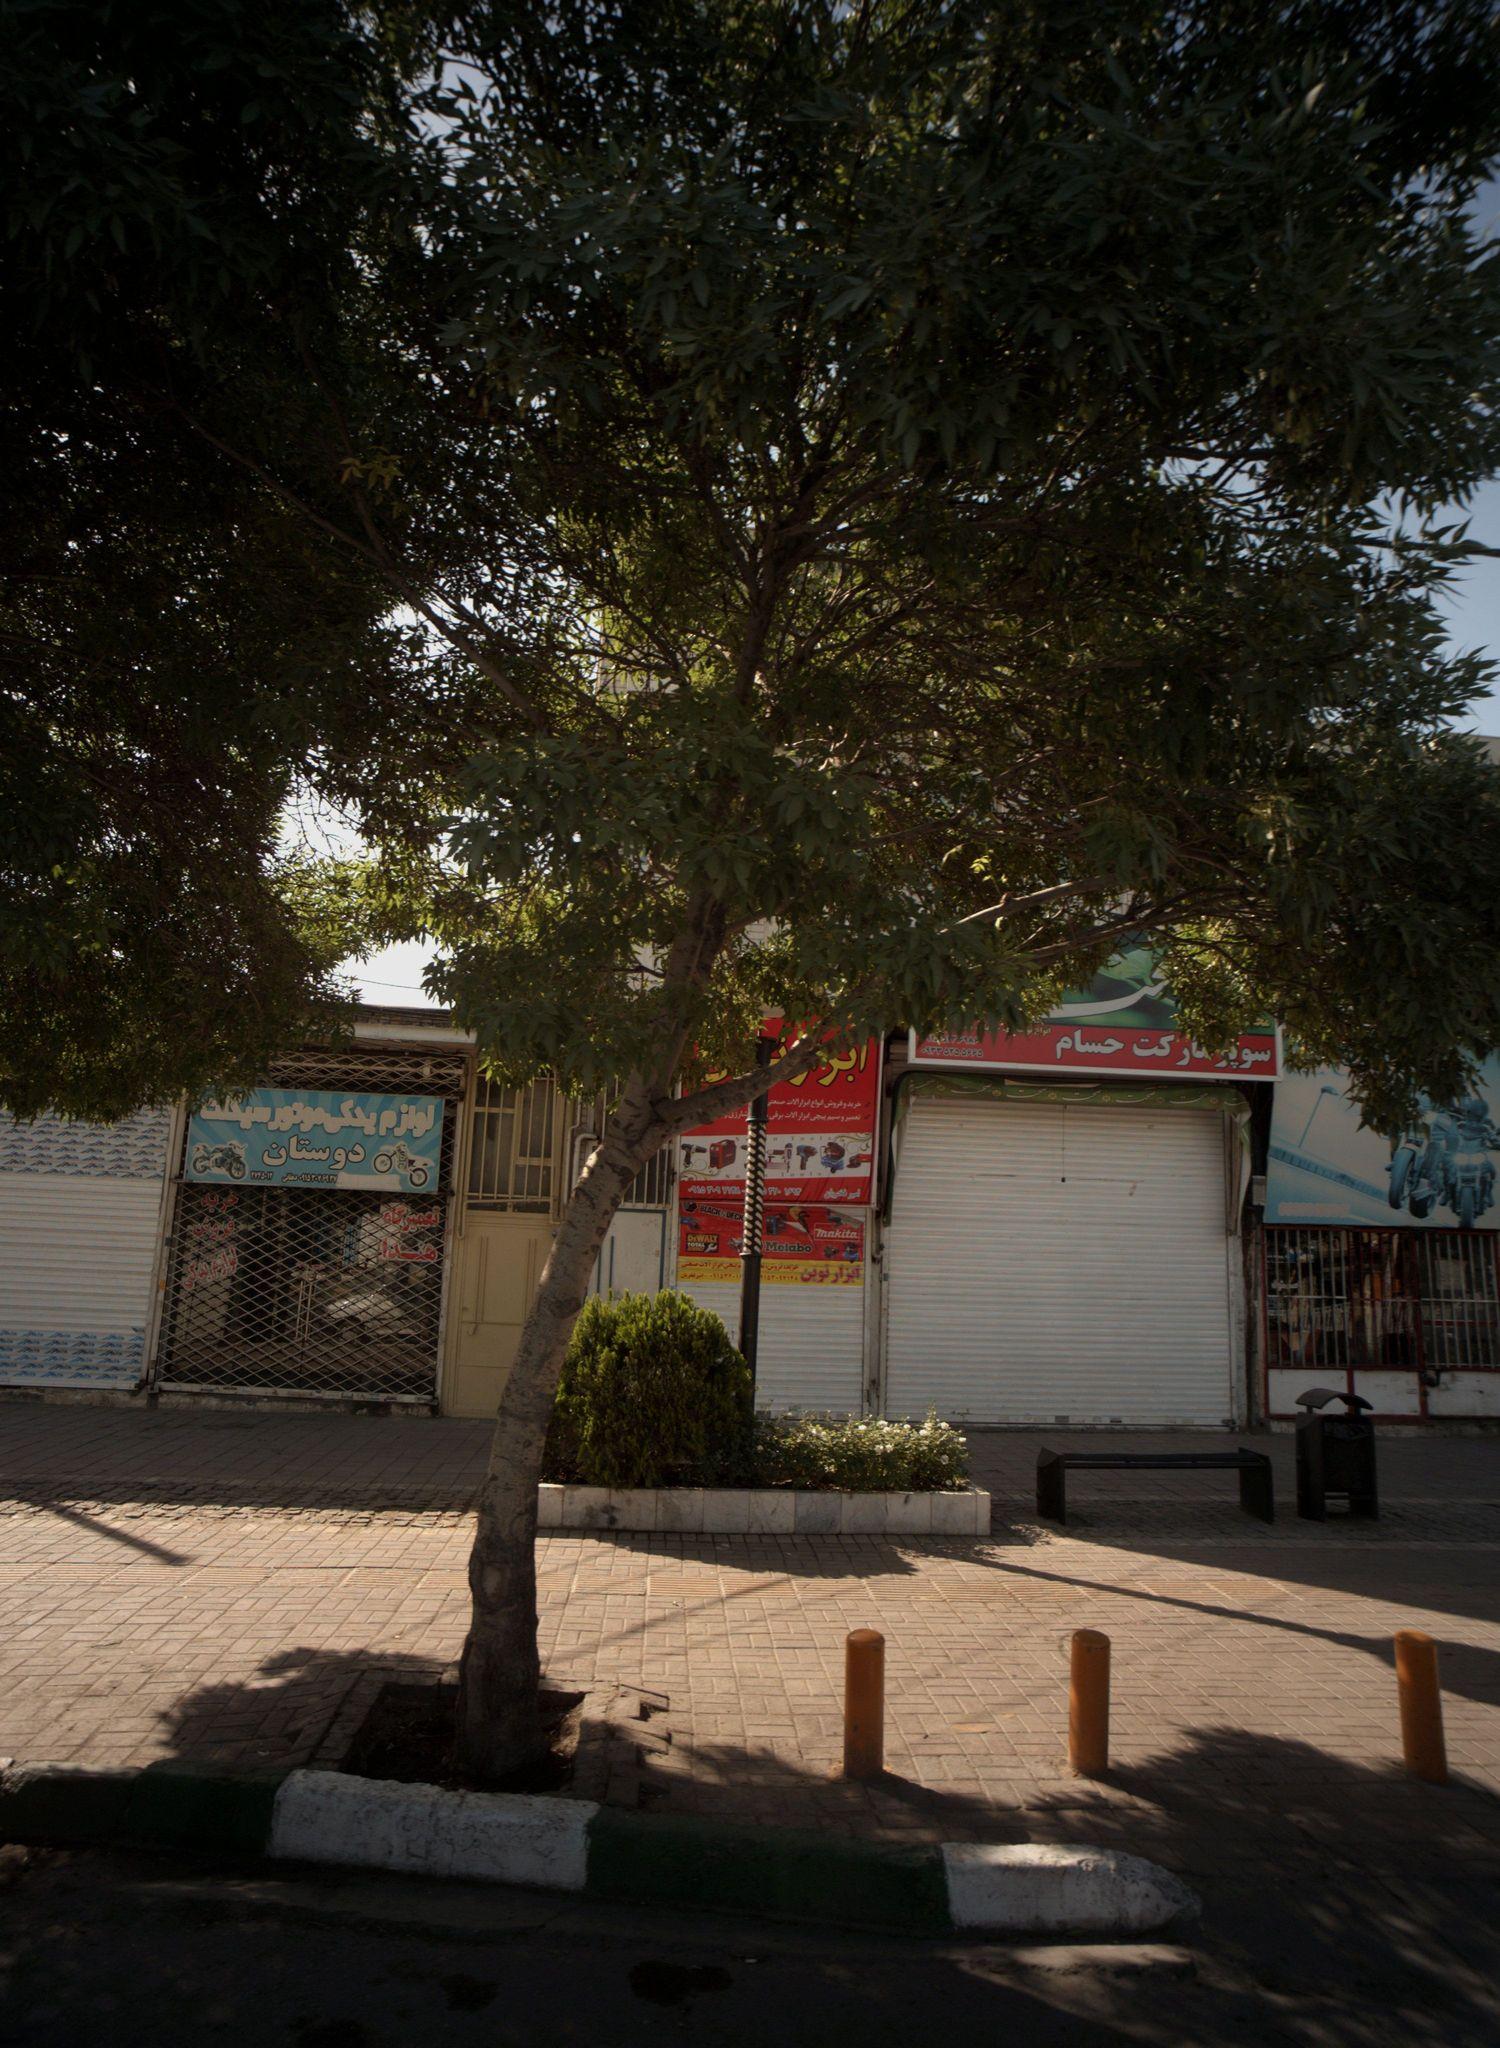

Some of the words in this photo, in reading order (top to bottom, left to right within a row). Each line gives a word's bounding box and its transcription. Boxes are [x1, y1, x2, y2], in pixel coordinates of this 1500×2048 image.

[1055, 1028, 1125, 1060] حسام
[379, 1103, 435, 1138] لوازم
[261, 1134, 367, 1171] دوستان
